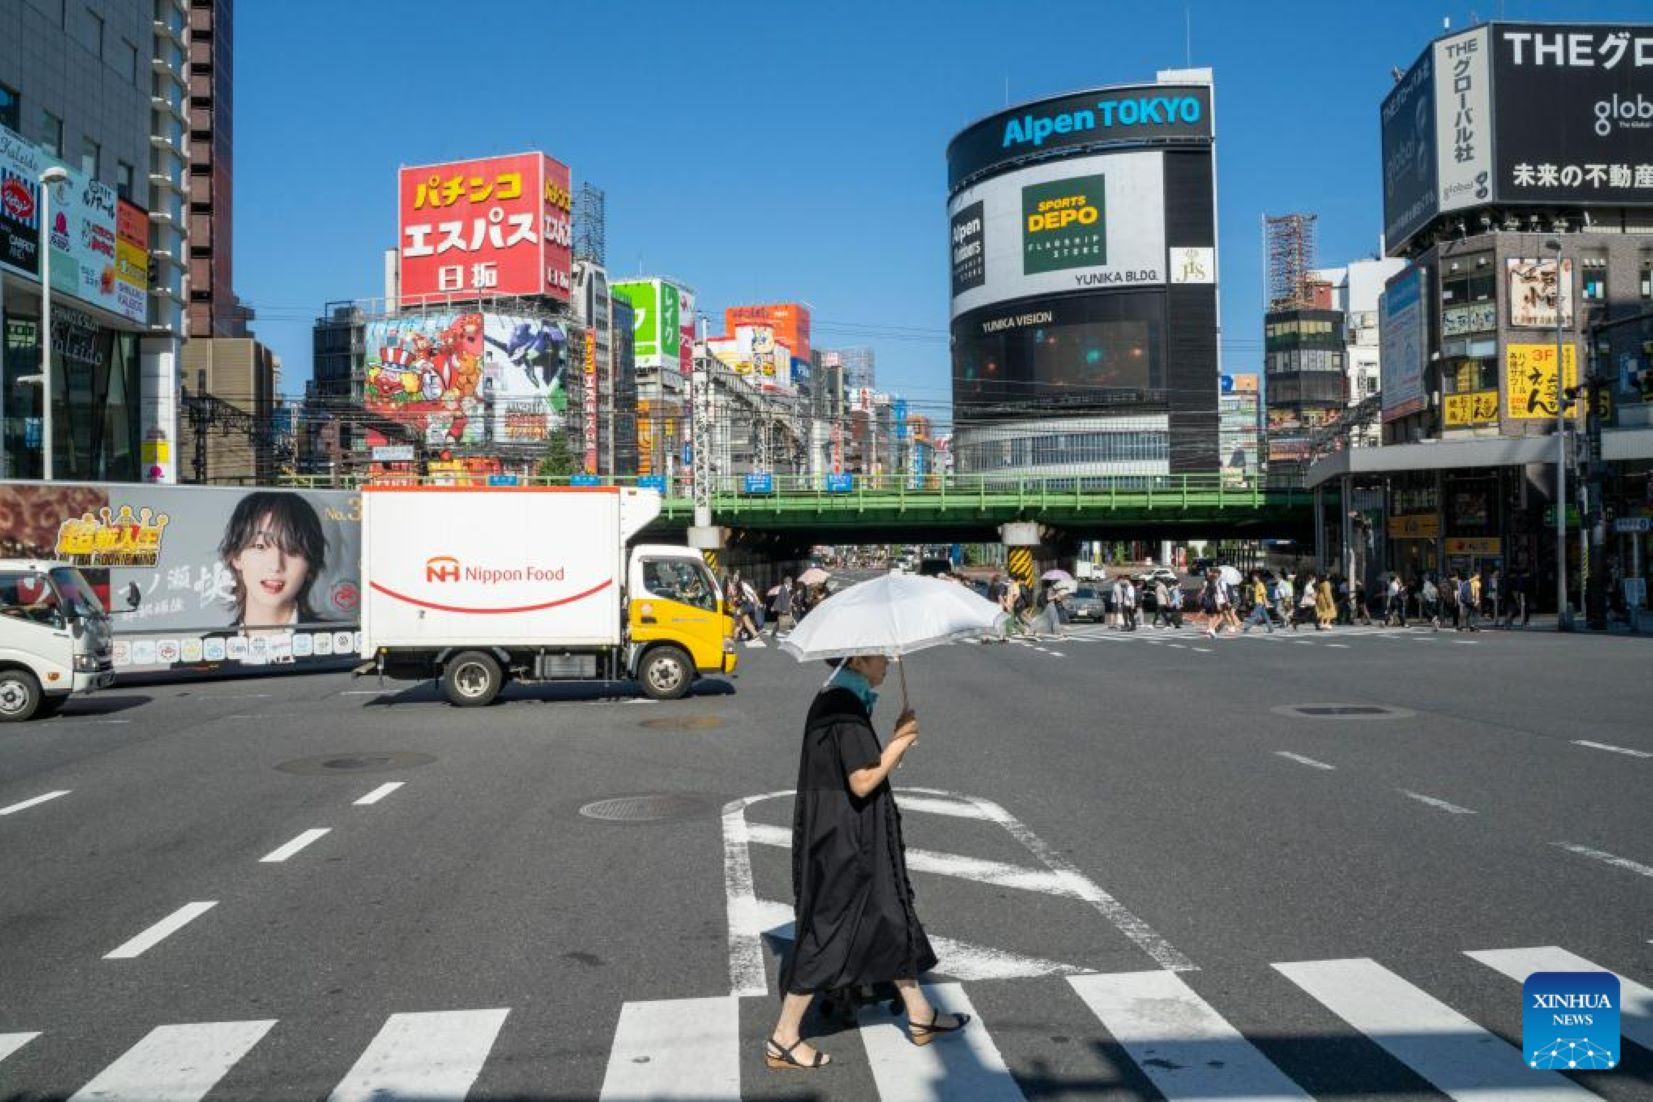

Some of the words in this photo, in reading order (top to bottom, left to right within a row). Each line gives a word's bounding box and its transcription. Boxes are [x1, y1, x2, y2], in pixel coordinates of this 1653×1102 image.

[1003, 110, 1095, 148] Alpen
[1099, 96, 1200, 127] TOKYO
[413, 171, 522, 209] パチンコ
[1037, 195, 1086, 212] SPORTS
[1028, 206, 1098, 232] DEPO
[403, 207, 538, 258] エスパス
[1075, 270, 1123, 285] YUNIKA
[1126, 269, 1159, 282] BLDG.
[983, 317, 1015, 333] YUNIKA
[1016, 311, 1053, 327] VISION
[1532, 349, 1553, 361] 3F
[465, 566, 522, 583] Nippon
[526, 565, 565, 581] Food
